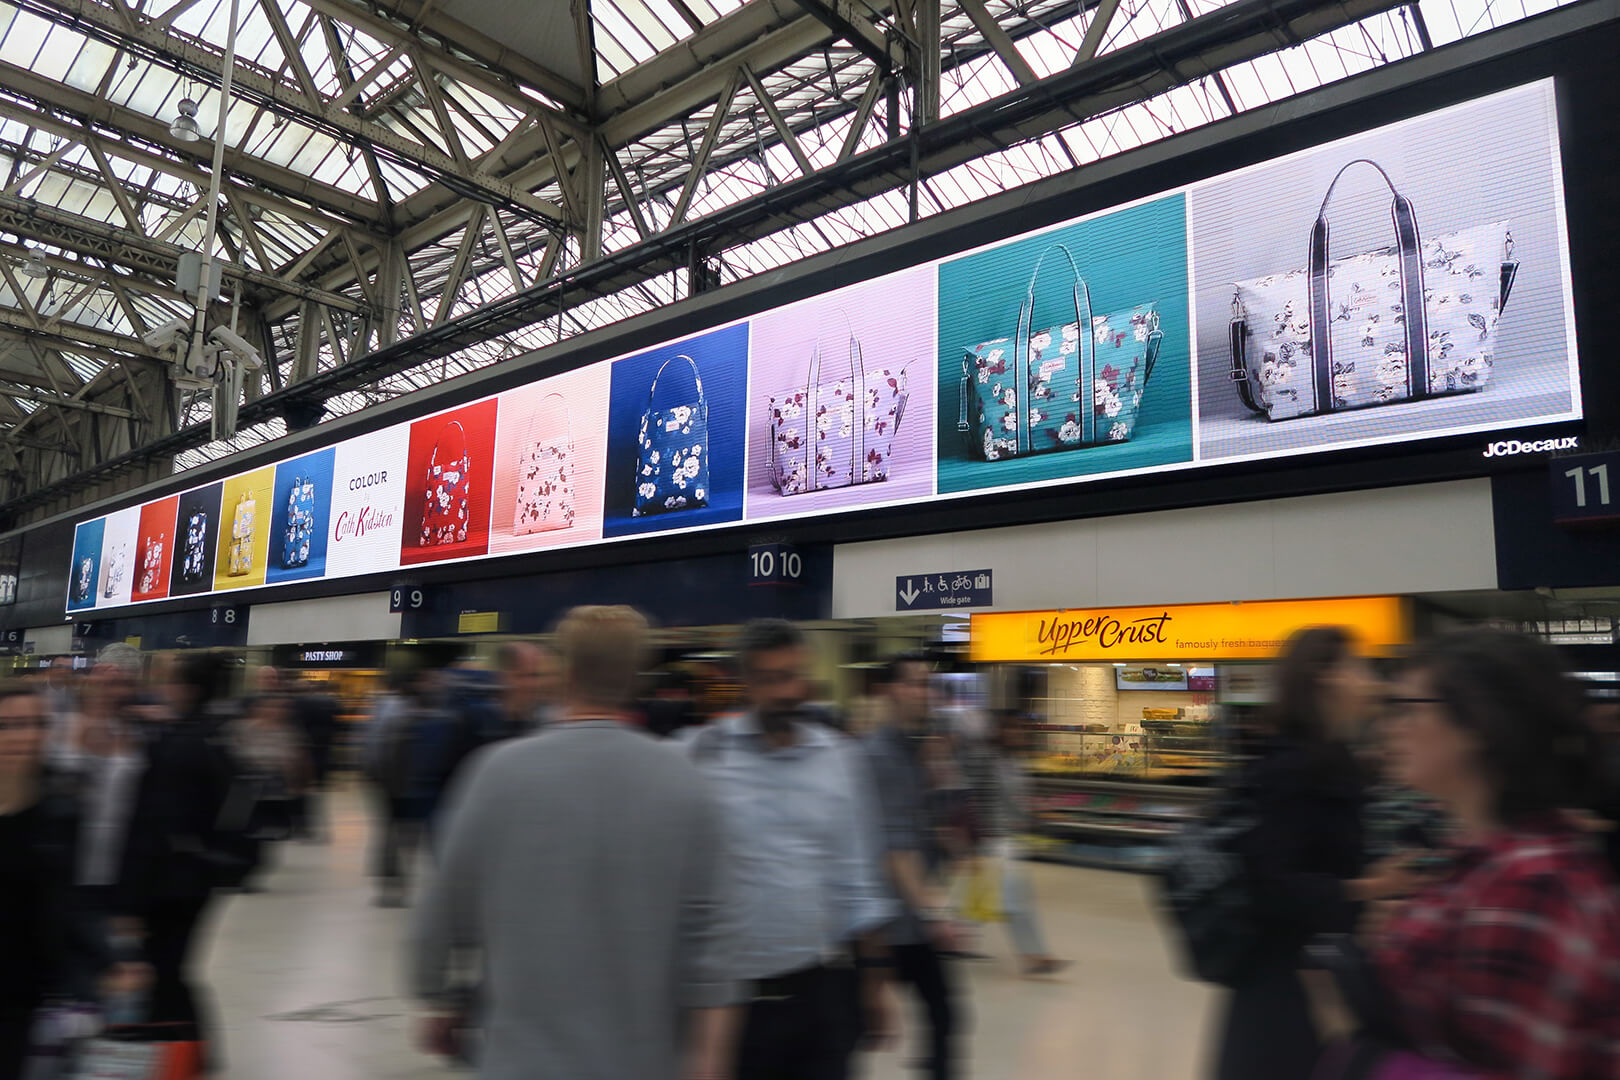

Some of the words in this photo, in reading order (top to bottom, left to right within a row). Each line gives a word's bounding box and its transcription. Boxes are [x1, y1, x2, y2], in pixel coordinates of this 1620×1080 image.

[1483, 436, 1578, 458] JCDecaux
[349, 470, 388, 491] COLOUR
[1565, 463, 1610, 507] 11
[335, 511, 355, 542] Cath
[355, 505, 393, 537] Kidston
[751, 551, 774, 577] 10
[780, 551, 801, 578] 10
[393, 590, 400, 608] 9
[410, 590, 423, 608] 9
[940, 597, 956, 605] Wide
[956, 596, 972, 605] gate
[212, 609, 217, 623] 8
[224, 609, 235, 623] 8
[8, 631, 17, 641] 6
[82, 624, 92, 635] 7
[1038, 615, 1110, 656] Upper
[1099, 611, 1173, 649] Crust
[1176, 638, 1218, 651] famously
[1221, 638, 1246, 648] fresh
[1248, 638, 1288, 651] bague
[305, 652, 325, 661] PASTY
[325, 651, 343, 661] SHOP
